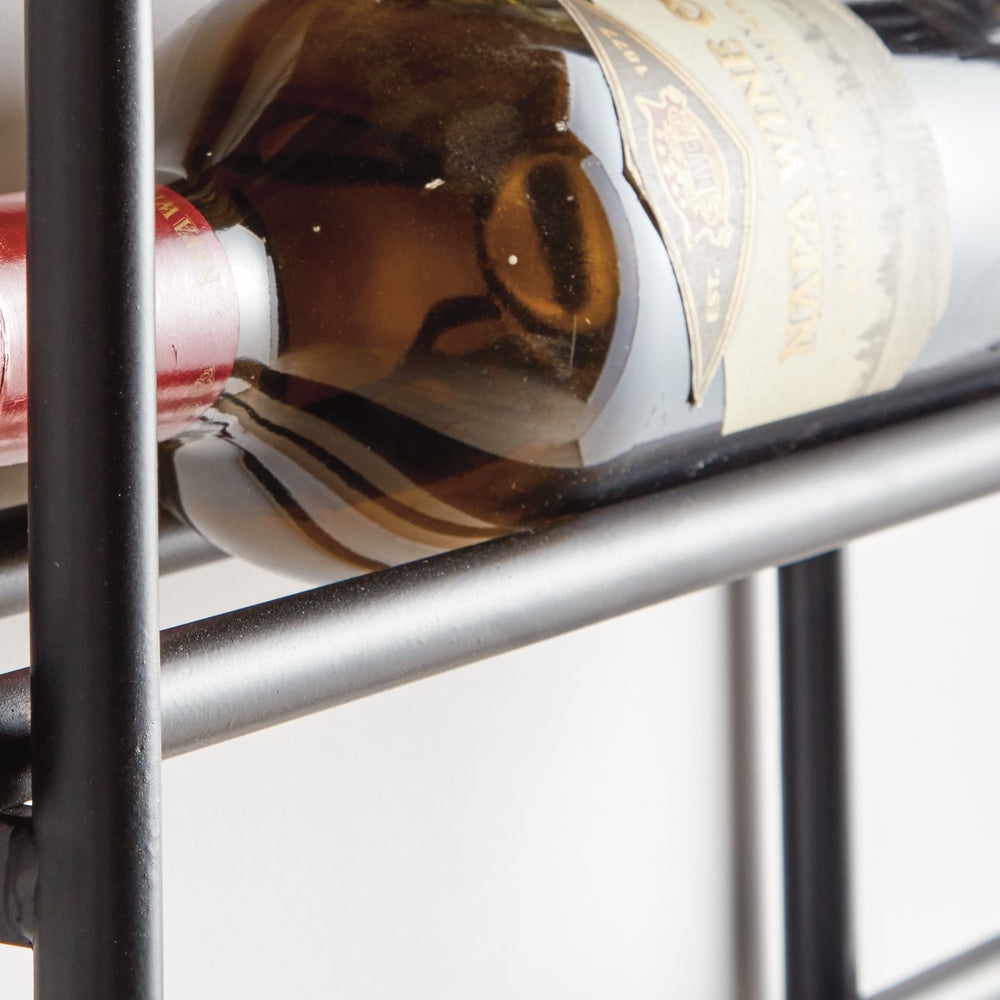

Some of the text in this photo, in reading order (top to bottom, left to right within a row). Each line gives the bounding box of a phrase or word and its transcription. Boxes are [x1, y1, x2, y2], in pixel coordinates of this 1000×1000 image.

[599, 26, 722, 323] EST. 1877
[706, 37, 804, 184] WINE
[777, 190, 825, 365] NAPA
